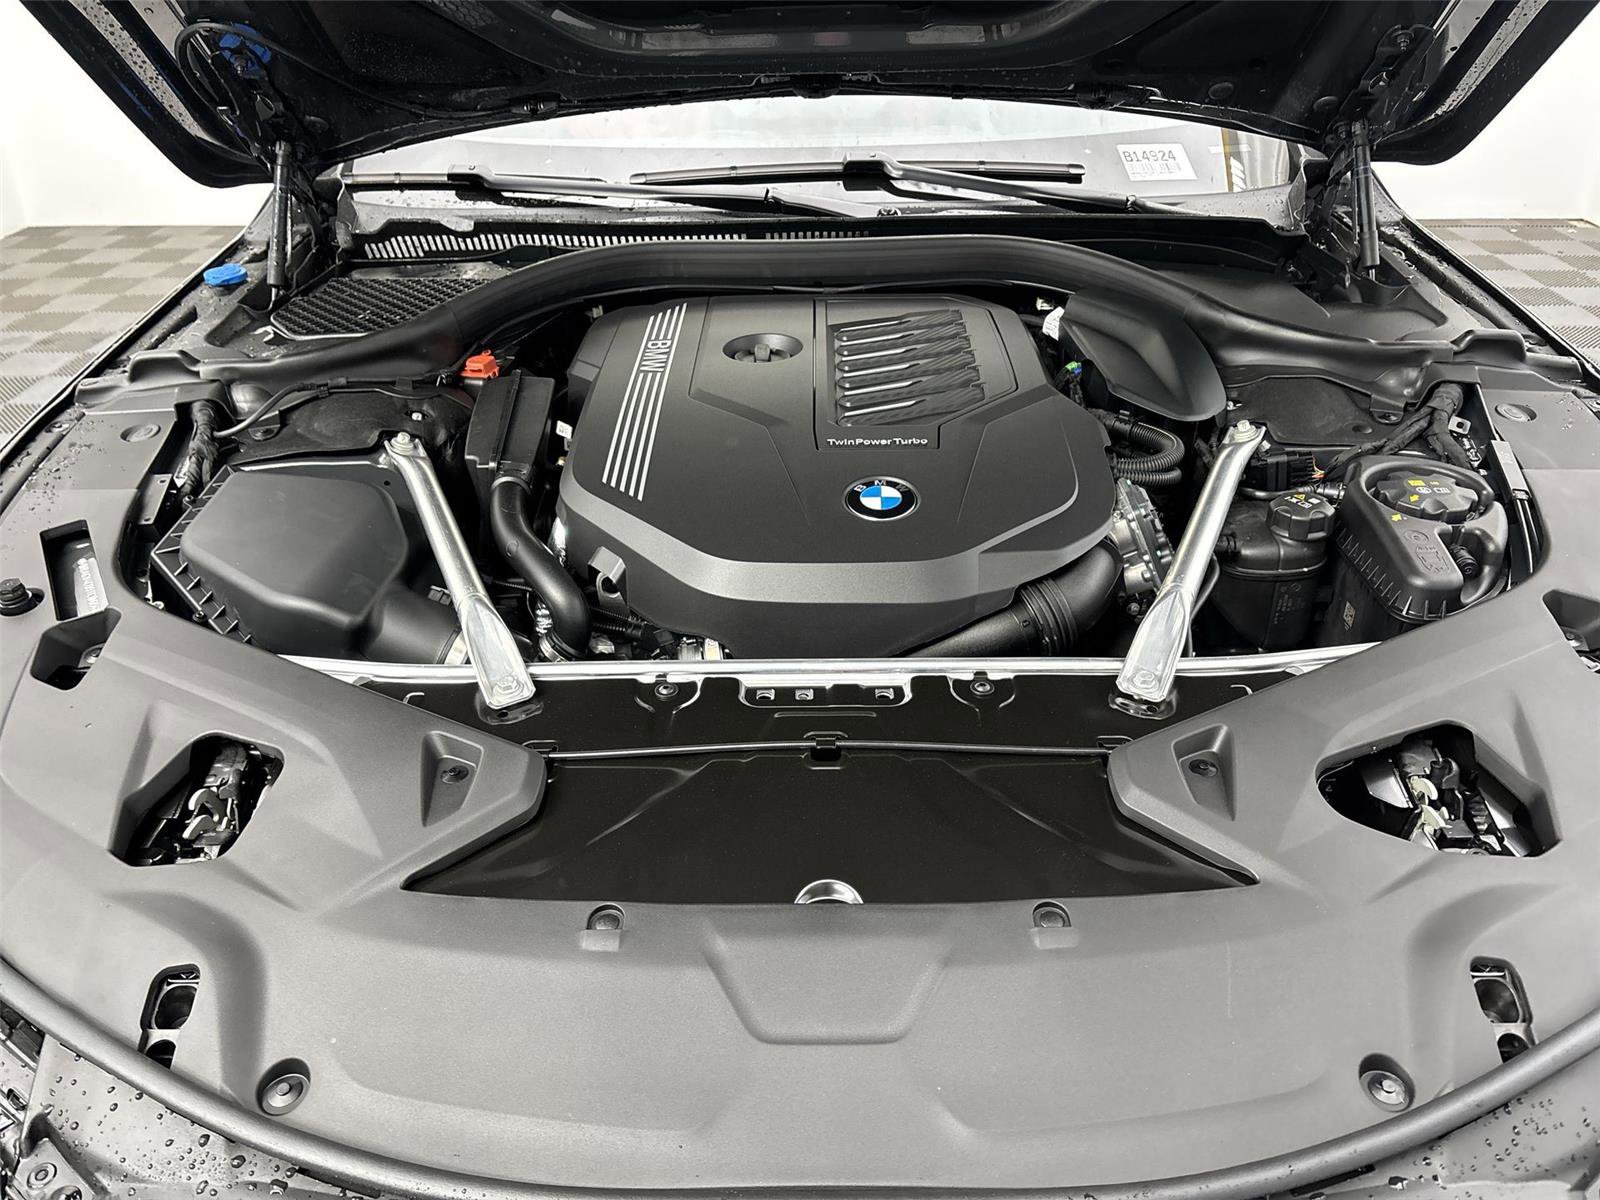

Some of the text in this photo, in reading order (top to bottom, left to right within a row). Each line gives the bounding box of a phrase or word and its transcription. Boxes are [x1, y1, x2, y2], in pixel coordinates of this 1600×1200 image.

[1122, 150, 1176, 162] B14924
[640, 340, 672, 372] BMW
[853, 480, 909, 492] BMW
